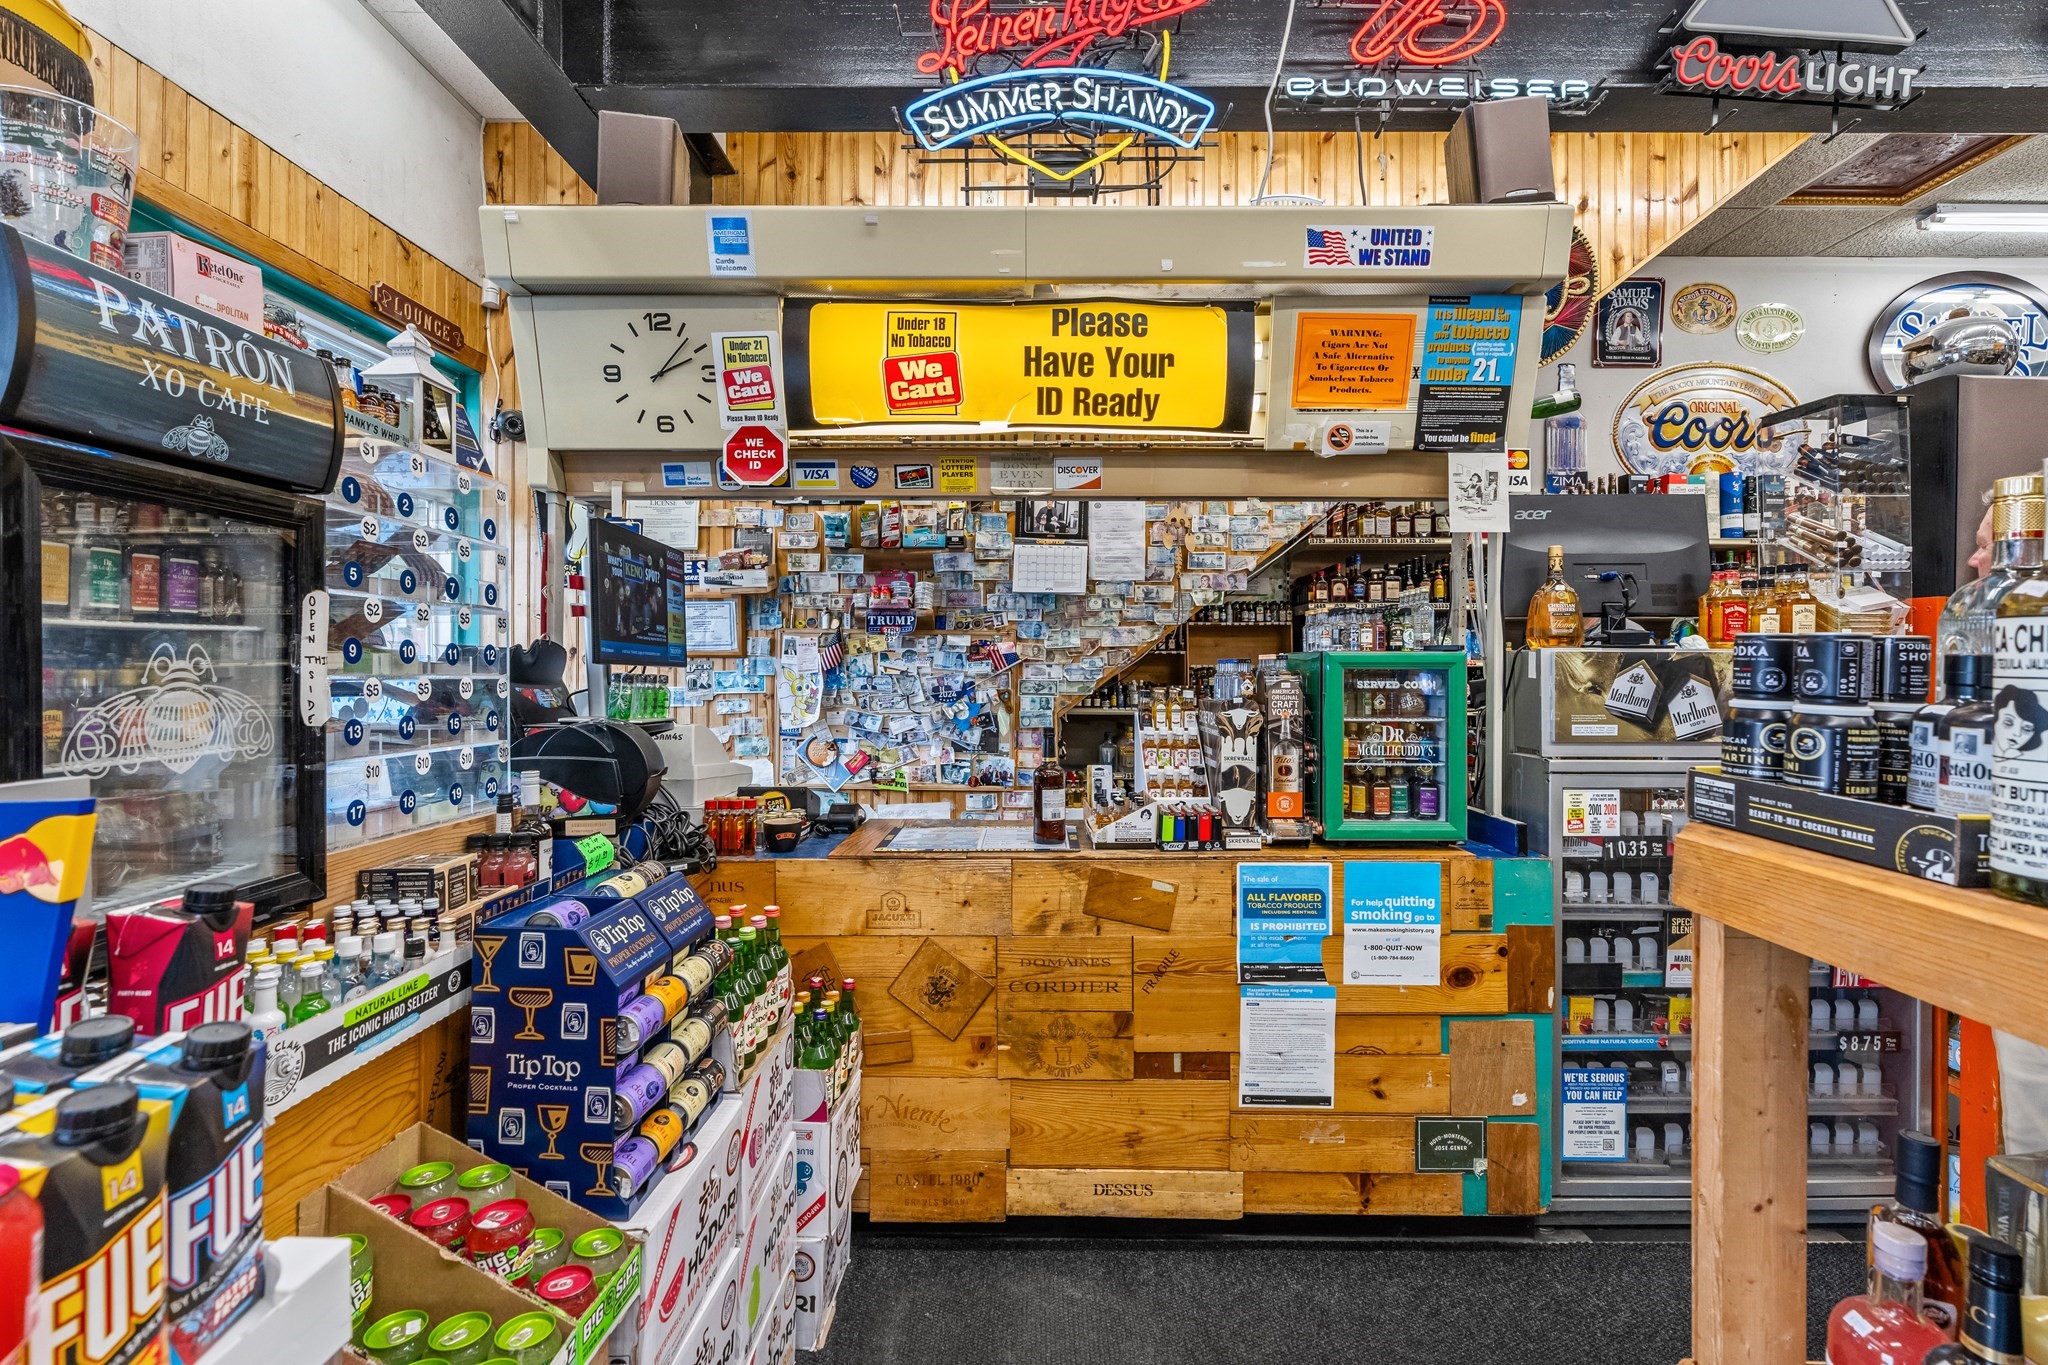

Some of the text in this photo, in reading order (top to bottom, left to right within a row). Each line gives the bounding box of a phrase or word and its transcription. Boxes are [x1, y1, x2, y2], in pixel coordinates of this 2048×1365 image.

[1673, 35, 1919, 100] Coors LIGHT
[1286, 77, 1589, 99] BUDWEISER
[924, 77, 1198, 138] SUMMER SHANDY
[1370, 228, 1422, 246] UNITED
[1359, 249, 1430, 266] WE STAND
[1608, 287, 1654, 299] SAMUEL
[1610, 298, 1649, 311] ADAMS
[393, 296, 450, 342] LOUNGE
[643, 312, 672, 331] 12
[1435, 307, 1496, 322] It is illegal
[897, 317, 946, 331] Under 18
[1051, 308, 1149, 337] Please
[89, 275, 296, 397] PATRÓN
[1330, 329, 1383, 338] WARNING:
[1452, 324, 1510, 339] tobacco
[729, 340, 762, 351] Under 21
[891, 332, 951, 348] No Tobacco
[1321, 341, 1388, 350] Cigars Are Not
[1428, 342, 1470, 353] products
[727, 352, 768, 363] No Tobacco
[1024, 345, 1175, 379] Have Your
[1323, 352, 1342, 360] Safe
[1345, 352, 1394, 361] Alternative
[604, 365, 622, 382] 9
[898, 360, 943, 381] We
[1316, 363, 1327, 371] To
[1330, 363, 1374, 372] Cigarettes
[1427, 358, 1501, 382] under 21.
[732, 370, 764, 385] We
[1309, 374, 1394, 383] Smokeless Tobacco
[140, 357, 270, 425] XO CAFE
[728, 382, 772, 400] Card
[889, 377, 955, 401] Card
[1329, 385, 1372, 394] Products.
[1653, 378, 1769, 401] THE ROCKY MOUNTAIN LEGEND
[1036, 386, 1160, 422] ID Ready
[1690, 402, 1740, 413] ORIGINAL
[657, 416, 674, 432] 6
[764, 414, 779, 422] Ready
[1645, 402, 1775, 449] Coors
[745, 438, 764, 447] WE
[1424, 432, 1496, 443] You could be fined
[363, 444, 375, 458] $1
[734, 450, 776, 459] CHECK
[749, 460, 762, 470] ID
[1057, 465, 1099, 474] DISCOVER
[802, 468, 830, 481] VISA
[1552, 476, 1583, 486] ZIMA
[1514, 509, 1552, 520] acer
[363, 521, 377, 536] $2
[625, 562, 642, 579] KENO
[868, 615, 916, 625] TRUMP
[461, 682, 471, 693] $20
[1609, 685, 1651, 711] Marlboro
[1672, 698, 1718, 728] Marlboro
[1588, 804, 1618, 816] 2001 2001
[1749, 809, 1875, 845] READY-TO-MIX COCKTAIL SHAKER
[1366, 899, 1383, 907] help
[1385, 896, 1435, 908] quitting
[872, 913, 916, 922] JACUZZI
[1351, 910, 1412, 923] smoking
[1262, 922, 1327, 930] PROHIBITED
[216, 938, 235, 955] 14
[1019, 957, 1111, 968] DOMAINES
[1141, 948, 1180, 995] FRAGILE
[1009, 980, 1121, 994] CORDIER
[355, 980, 419, 1020] NATURAL LIME
[327, 1032, 347, 1056] THE
[348, 1017, 381, 1042] ICONIC
[382, 1002, 406, 1026] HARD
[406, 986, 438, 1013] SELTZER
[506, 1054, 581, 1080] Tip Top
[1564, 1073, 1624, 1083] WE'RE SERIOUS
[507, 1082, 578, 1092] PROPER COCKTAILS
[1566, 1091, 1623, 1100] YOU CAN HELP
[876, 1093, 959, 1134] Niente
[895, 1173, 981, 1187] CASTEL 1980
[1093, 1184, 1154, 1197] DESSUS
[656, 1217, 677, 1286] IMPORTED
